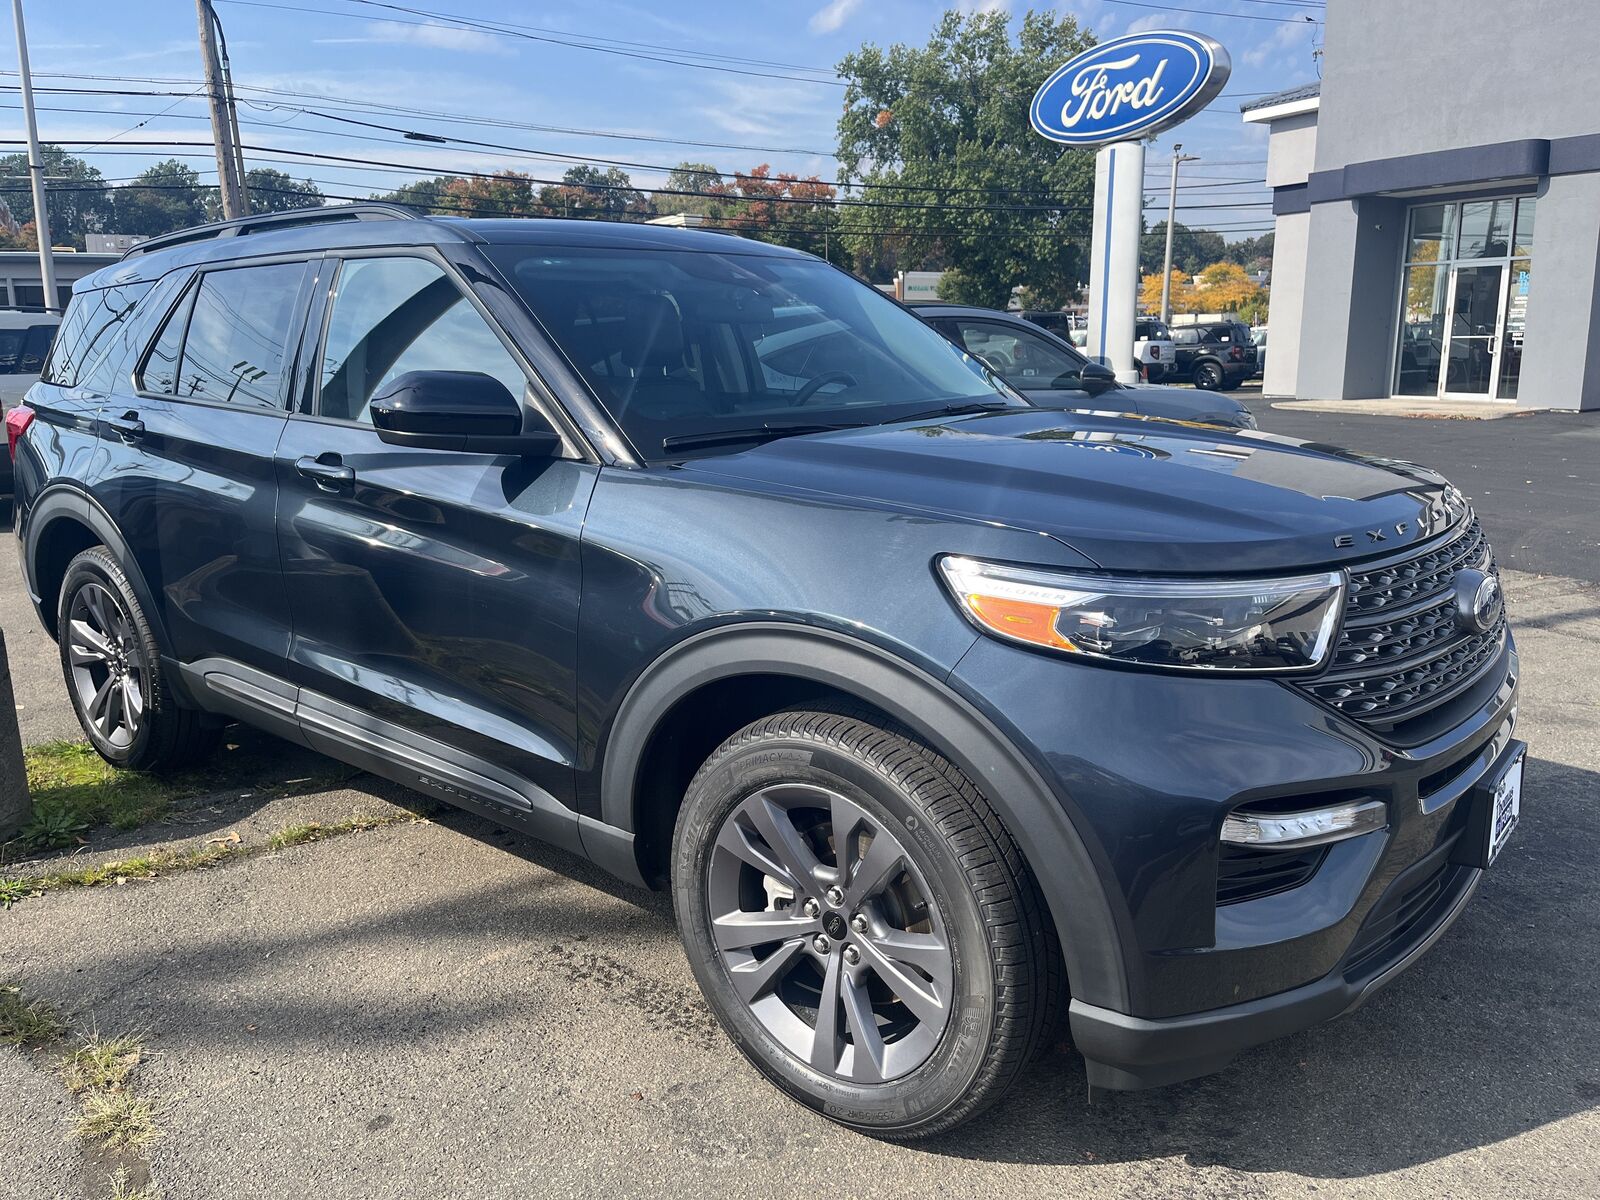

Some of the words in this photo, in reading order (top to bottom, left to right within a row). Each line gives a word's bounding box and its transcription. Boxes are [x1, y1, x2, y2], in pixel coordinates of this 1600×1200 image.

[1061, 53, 1168, 128] Ford
[740, 751, 784, 769] PRIMACY
[418, 776, 527, 821] EXPLORER
[829, 1105, 843, 1115] 20
